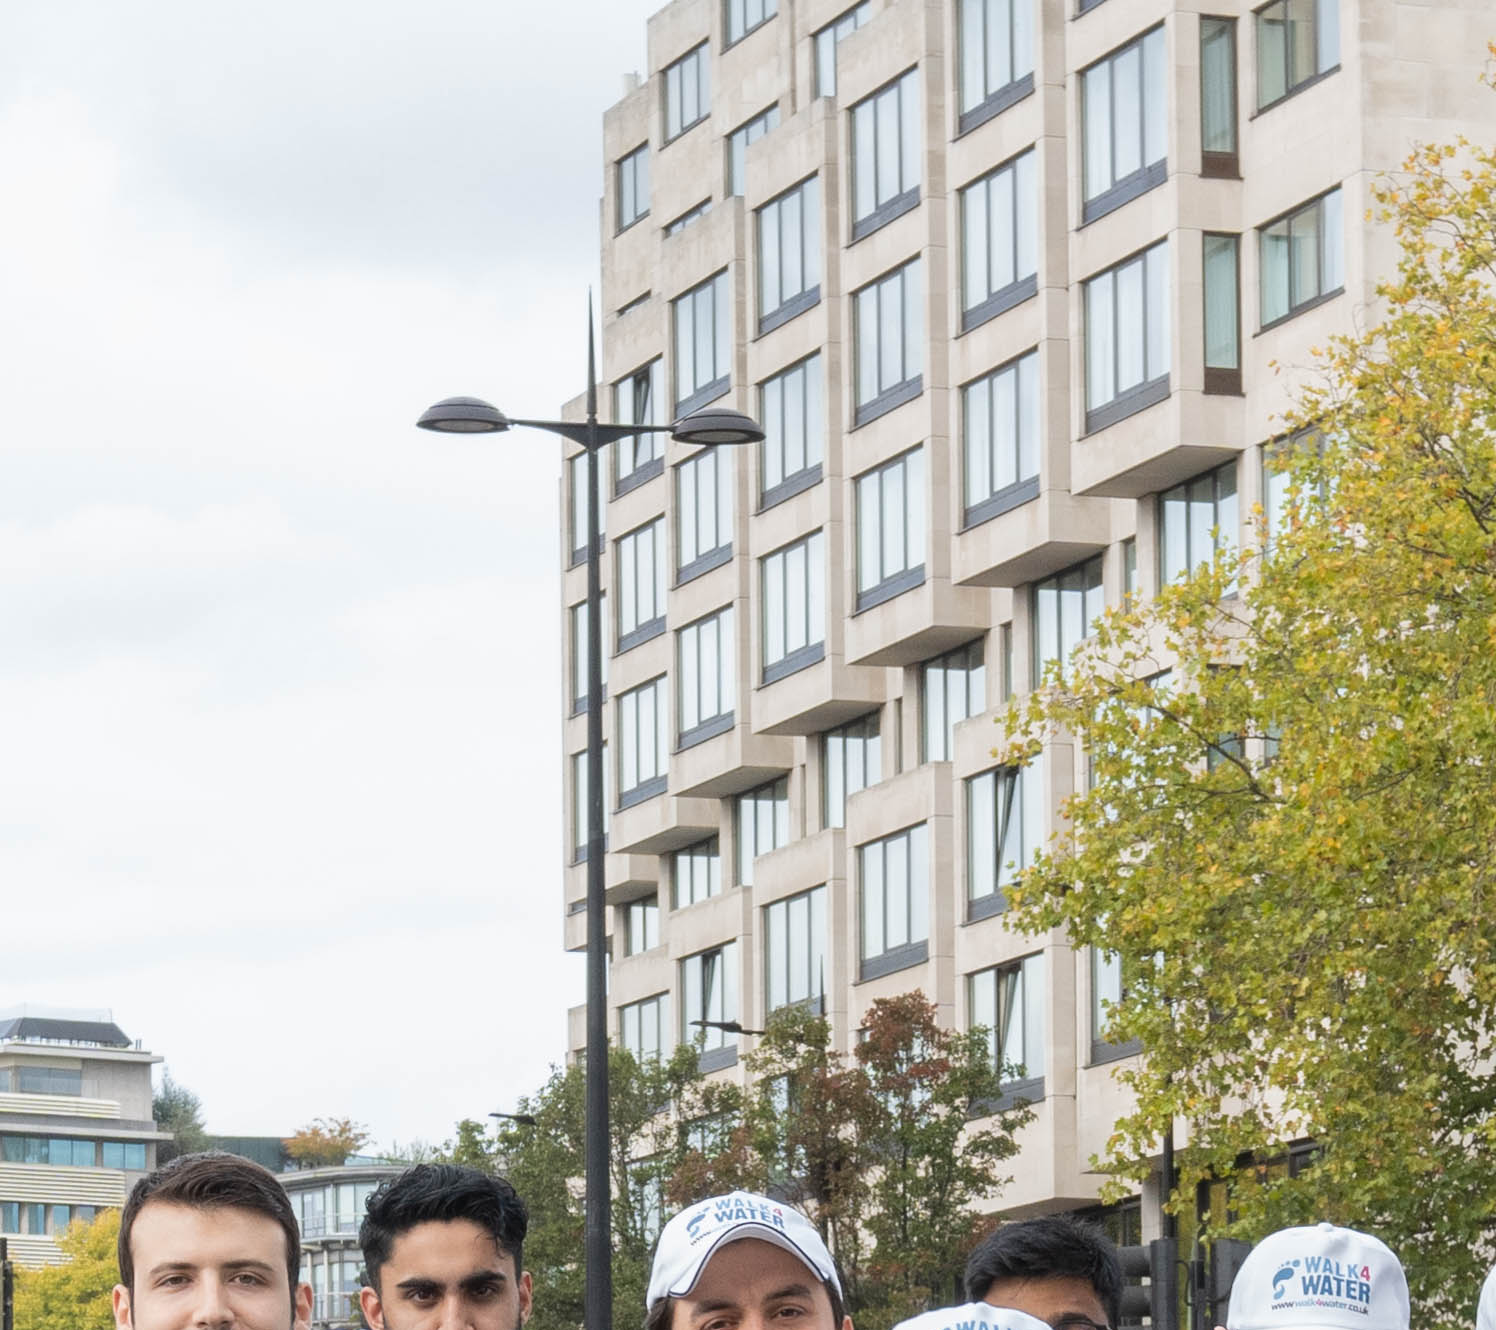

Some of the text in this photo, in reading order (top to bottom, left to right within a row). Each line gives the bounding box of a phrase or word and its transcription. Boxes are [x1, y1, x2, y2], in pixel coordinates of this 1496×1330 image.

[714, 1208, 784, 1229] WATER
[715, 1198, 783, 1217] WALK4
[1304, 1256, 1371, 1281] WALK4
[1301, 1274, 1371, 1304] WATER
